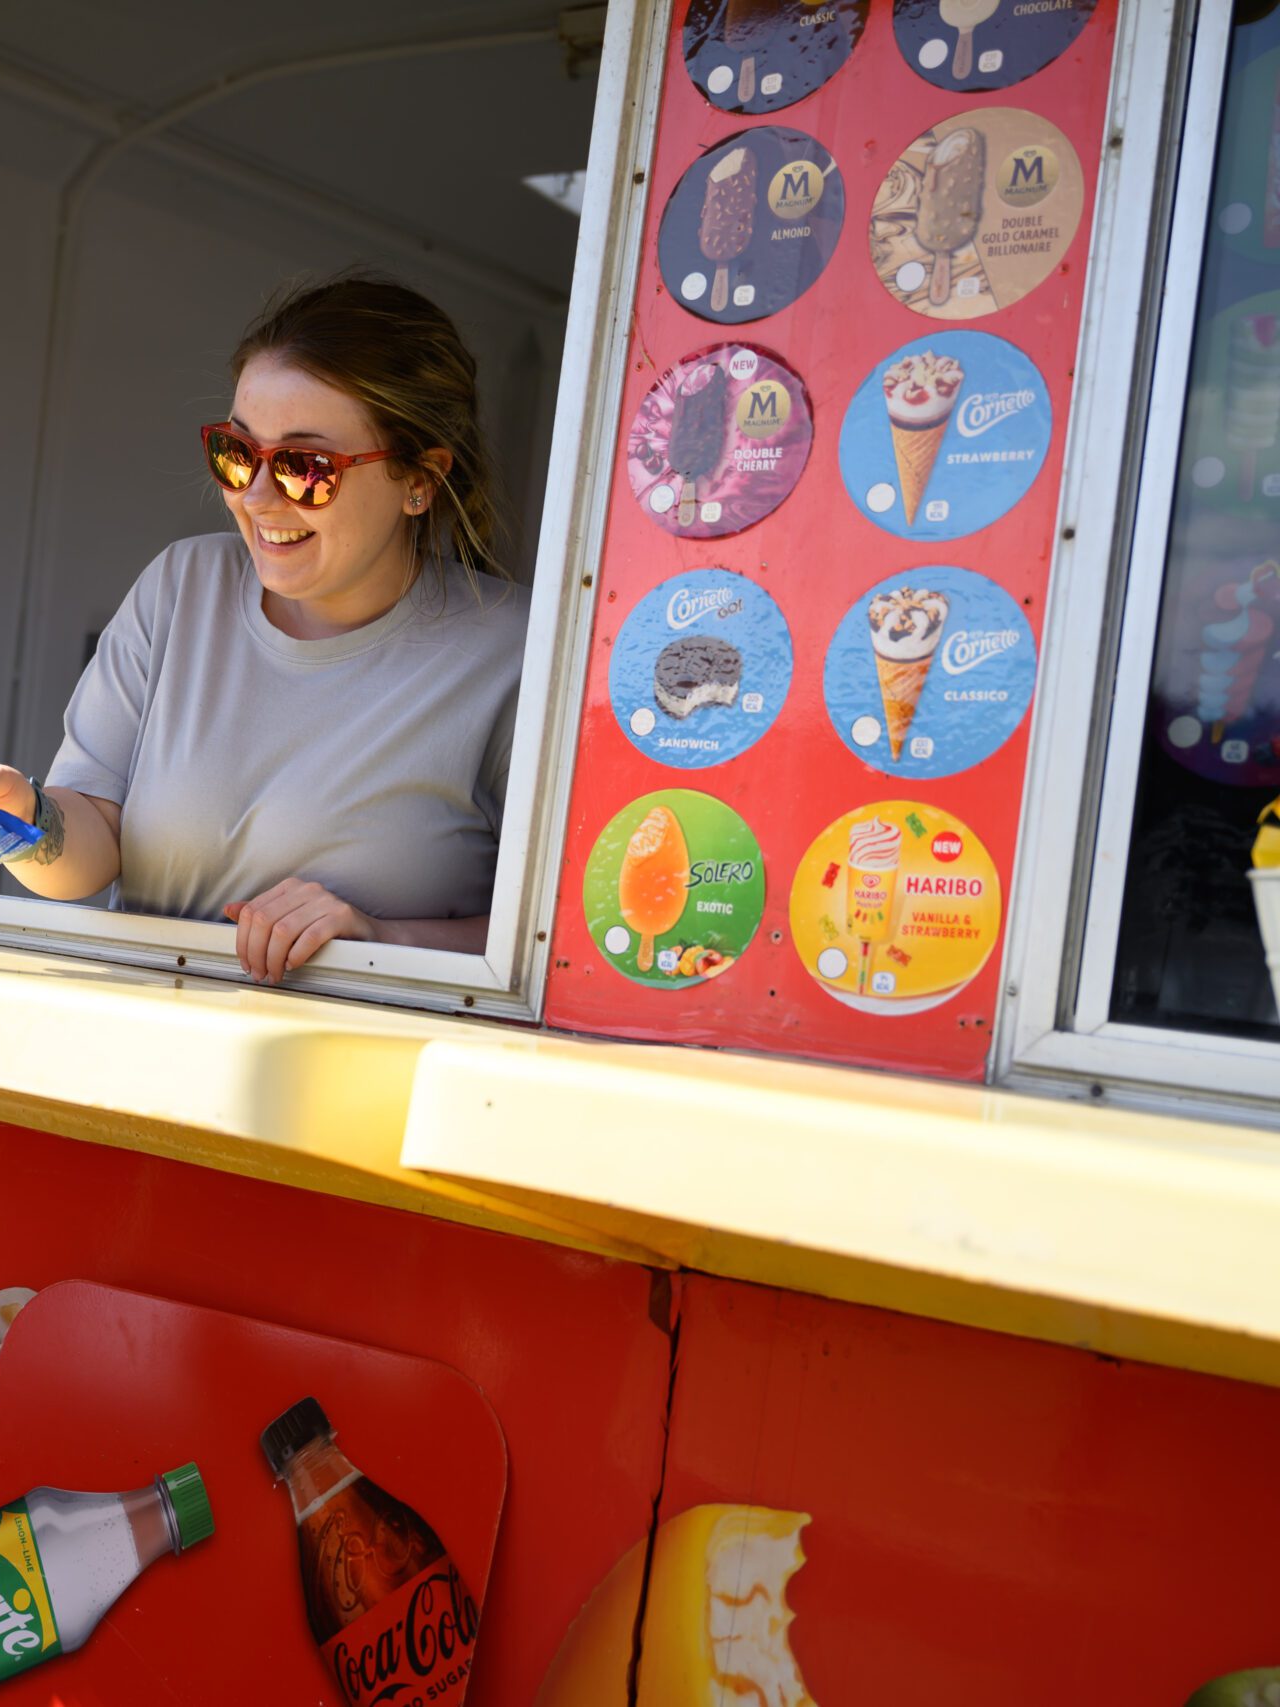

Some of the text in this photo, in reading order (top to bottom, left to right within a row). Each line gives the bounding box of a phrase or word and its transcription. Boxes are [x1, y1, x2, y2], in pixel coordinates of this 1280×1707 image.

[1013, 0, 1073, 17] CHOCOLATE
[799, 10, 837, 27] CLASSIC
[775, 197, 813, 208] MAGNUM
[1001, 215, 1043, 229] DOUBLE
[770, 226, 811, 240] ALMOND
[982, 227, 1060, 244] GOLD CARAMEL
[987, 241, 1052, 257] BILLIONAIRE
[732, 359, 756, 371] NEW
[956, 389, 1036, 438] Cornetto
[733, 447, 783, 460] DOUBLE
[946, 450, 1036, 465] STRAWBERRY
[736, 459, 778, 472] CHERRY
[666, 587, 744, 630] Cornetto GO!
[941, 629, 1020, 676] Cornetto
[943, 690, 1009, 702] CLASSICO
[658, 737, 720, 750] SANDWICH
[932, 840, 962, 854] NEW
[684, 861, 754, 888] SOLERO
[906, 876, 983, 897] HARIBO
[854, 889, 888, 900] HARIBO
[696, 900, 734, 915] EXOTIC
[911, 911, 961, 925] VANILLA
[900, 924, 981, 940] STRAWBERRY
[333, 1562, 479, 1707] Coca-Cola
